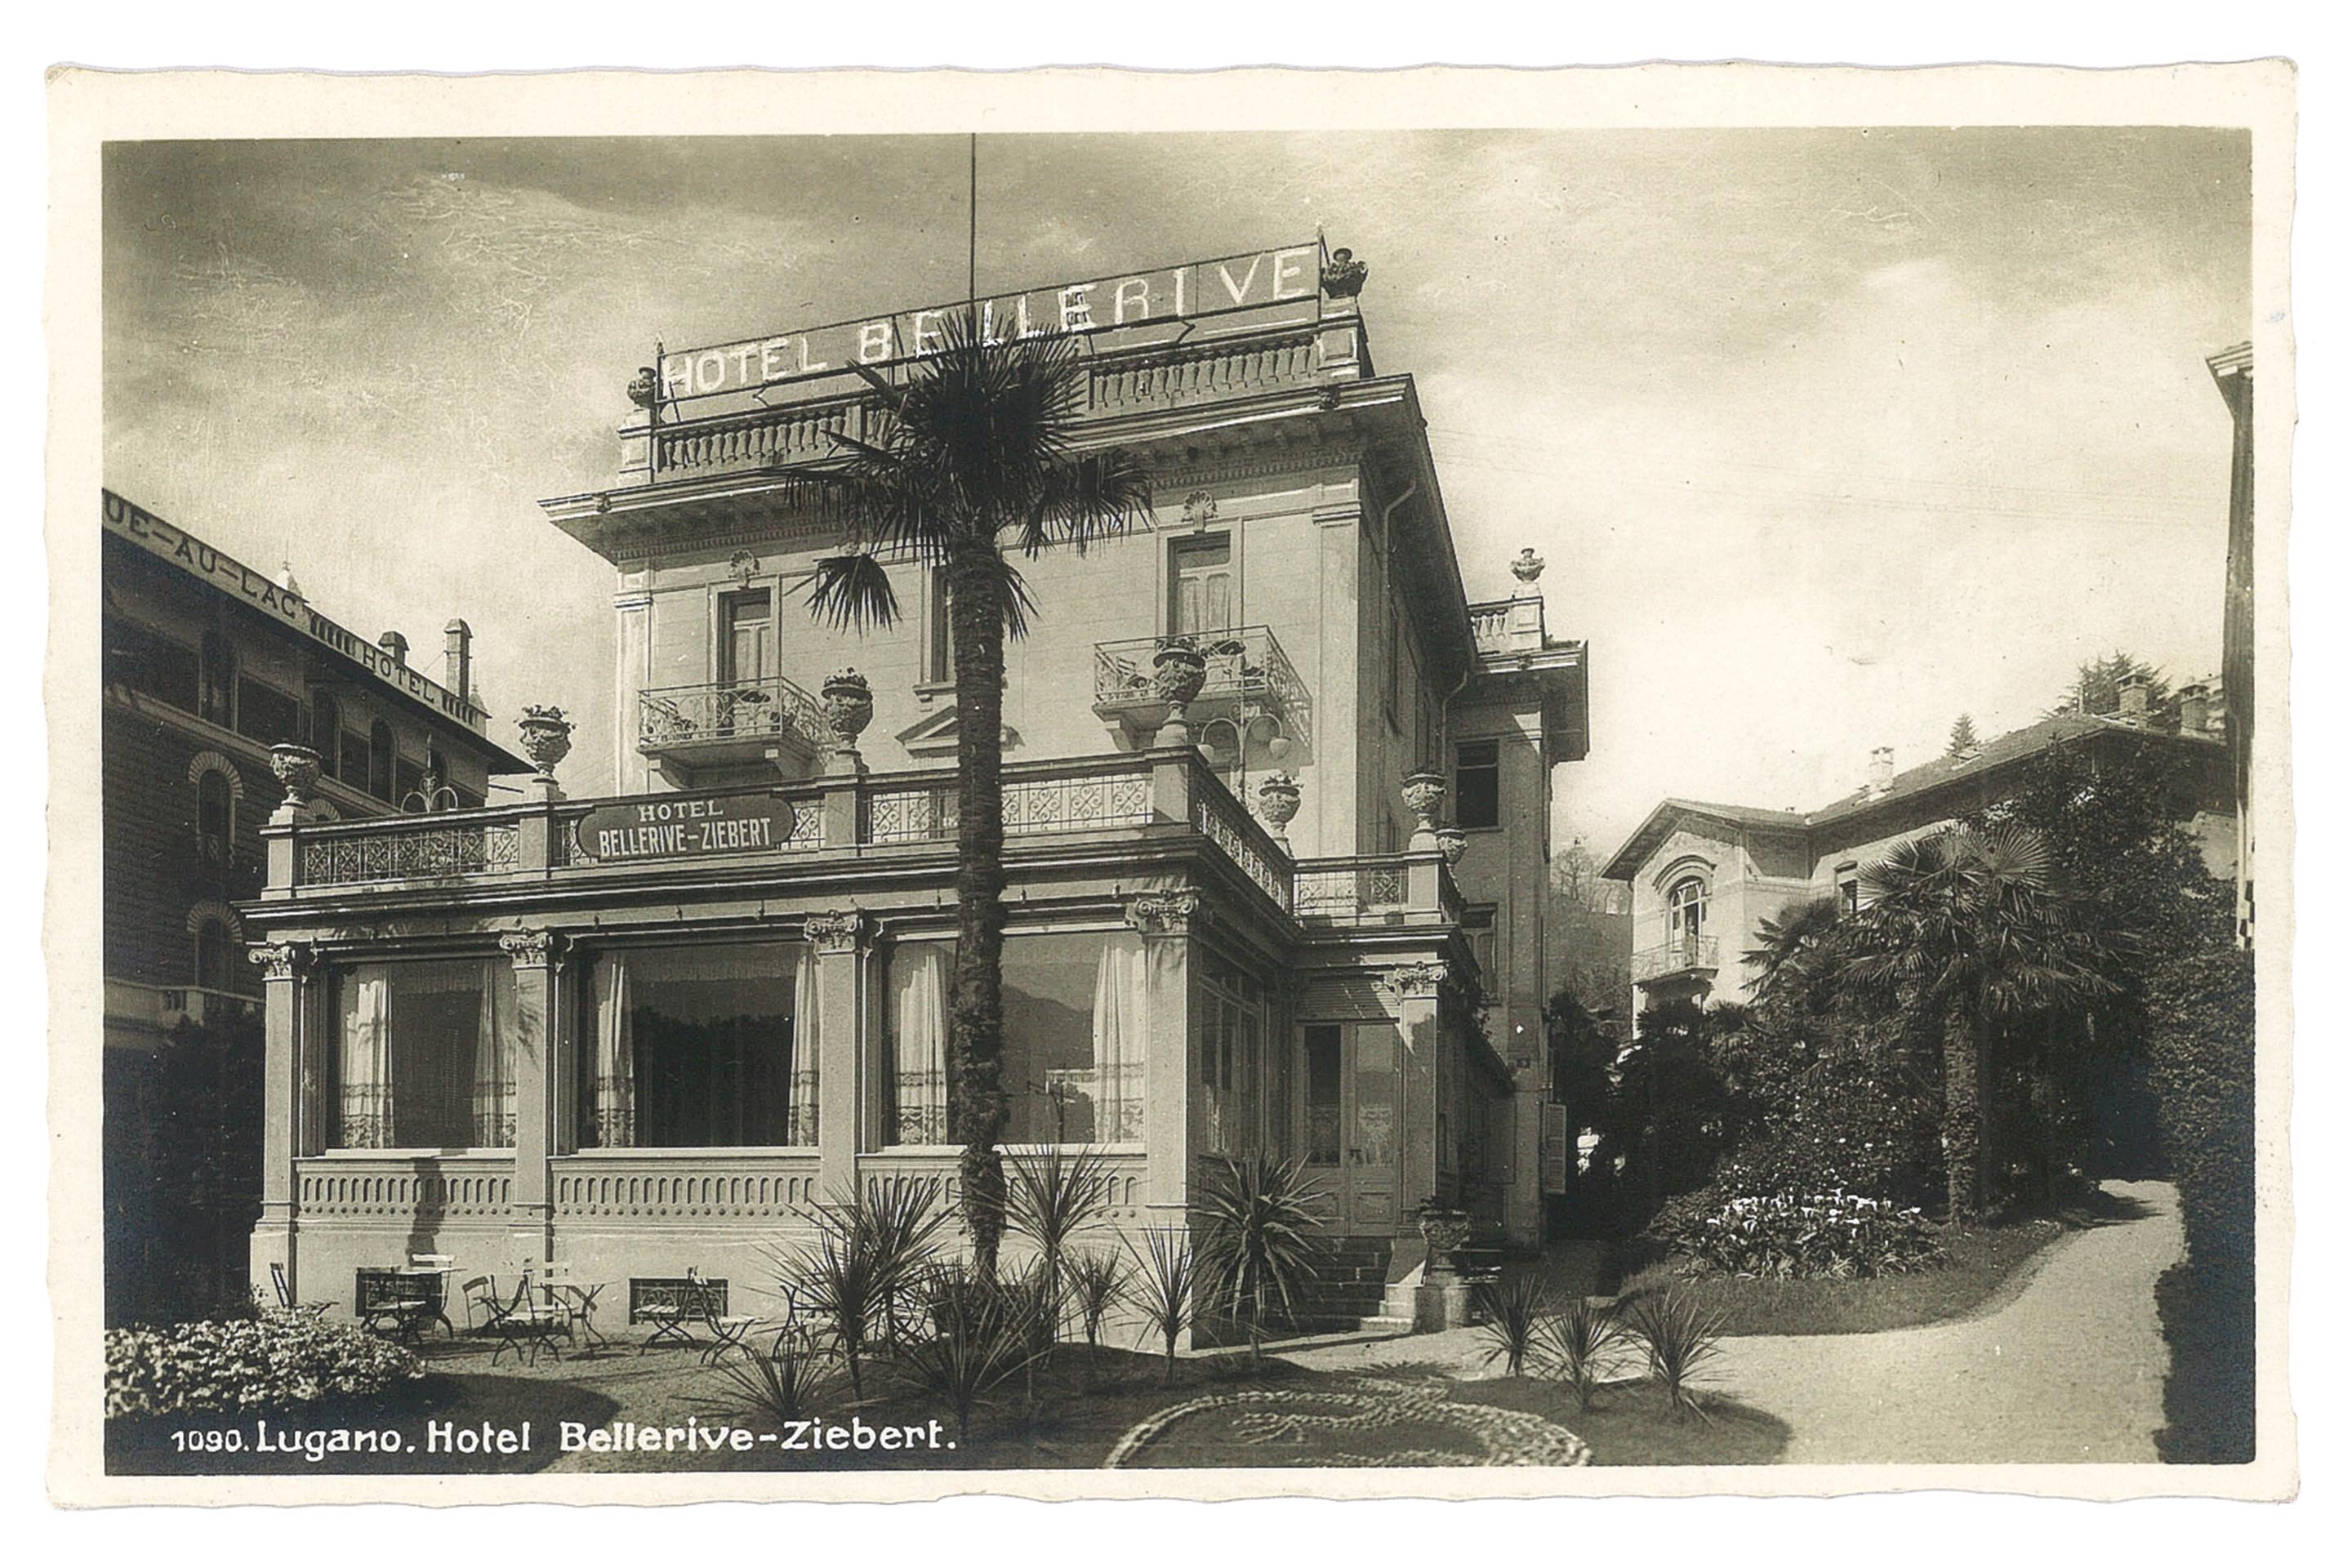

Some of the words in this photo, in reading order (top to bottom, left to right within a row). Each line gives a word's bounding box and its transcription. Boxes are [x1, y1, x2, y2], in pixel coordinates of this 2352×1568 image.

[661, 336, 827, 399] HOTEL
[858, 247, 1312, 366] BELLERIVE
[362, 645, 435, 704] HOTEL
[637, 800, 724, 822] HOTEL
[599, 817, 772, 858] BELLERIVE-ZIEBERT
